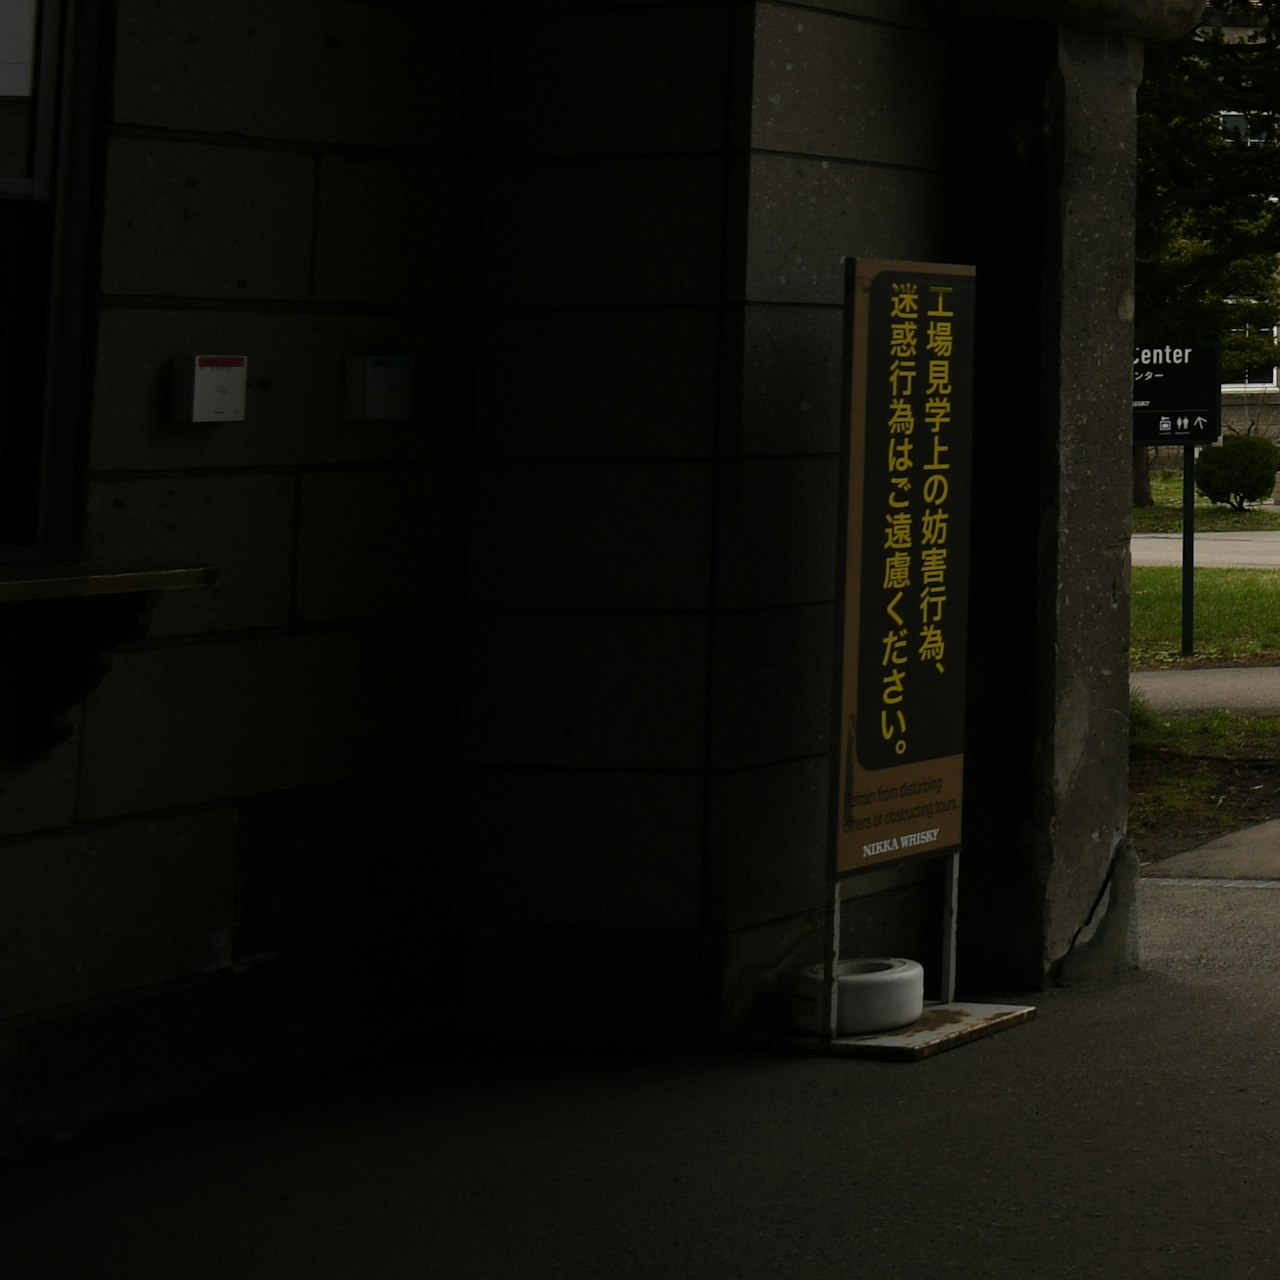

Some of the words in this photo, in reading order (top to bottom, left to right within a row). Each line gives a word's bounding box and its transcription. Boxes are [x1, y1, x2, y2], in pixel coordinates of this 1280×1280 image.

[918, 286, 955, 675] 工場見学上の妨害行為、
[879, 282, 919, 757] 迷惑行為はご遠慮ください。
[878, 785, 897, 801] from
[899, 776, 943, 797] disturbing
[873, 813, 883, 827] or
[884, 801, 934, 825] obstructing
[862, 837, 899, 858] NIKKA
[900, 827, 940, 849] WHISKY
